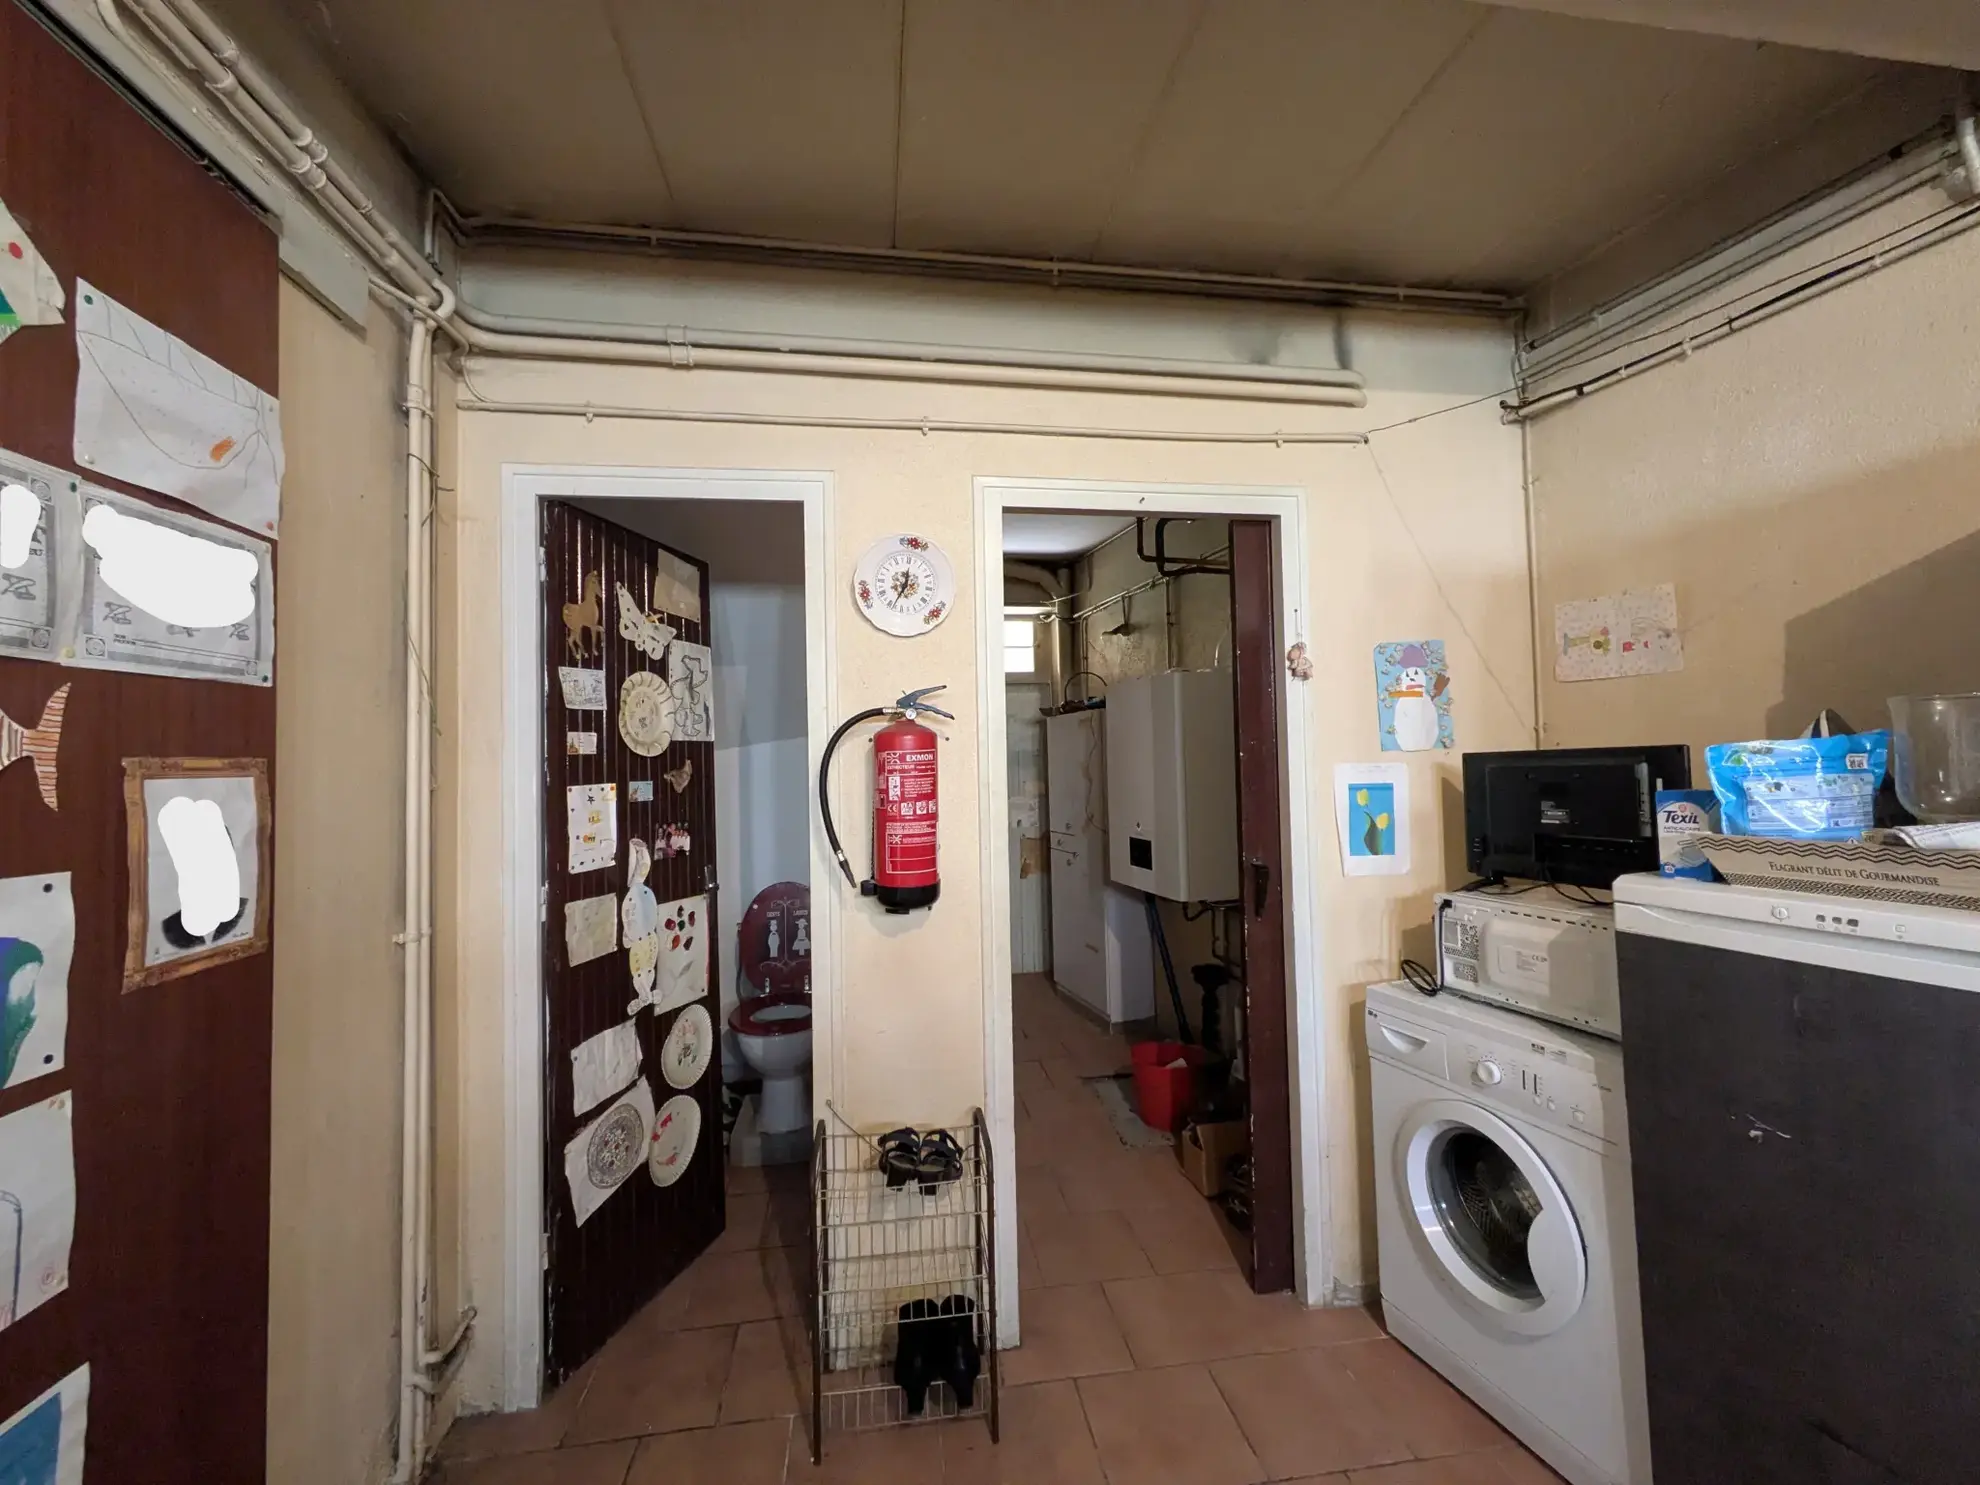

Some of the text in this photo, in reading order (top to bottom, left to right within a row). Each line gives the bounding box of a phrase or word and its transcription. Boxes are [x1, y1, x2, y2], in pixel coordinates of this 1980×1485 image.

[906, 753, 933, 761] EXMON
[1768, 861, 1940, 886] FLAGRANT DÉLIT DE GOURMANDISE
